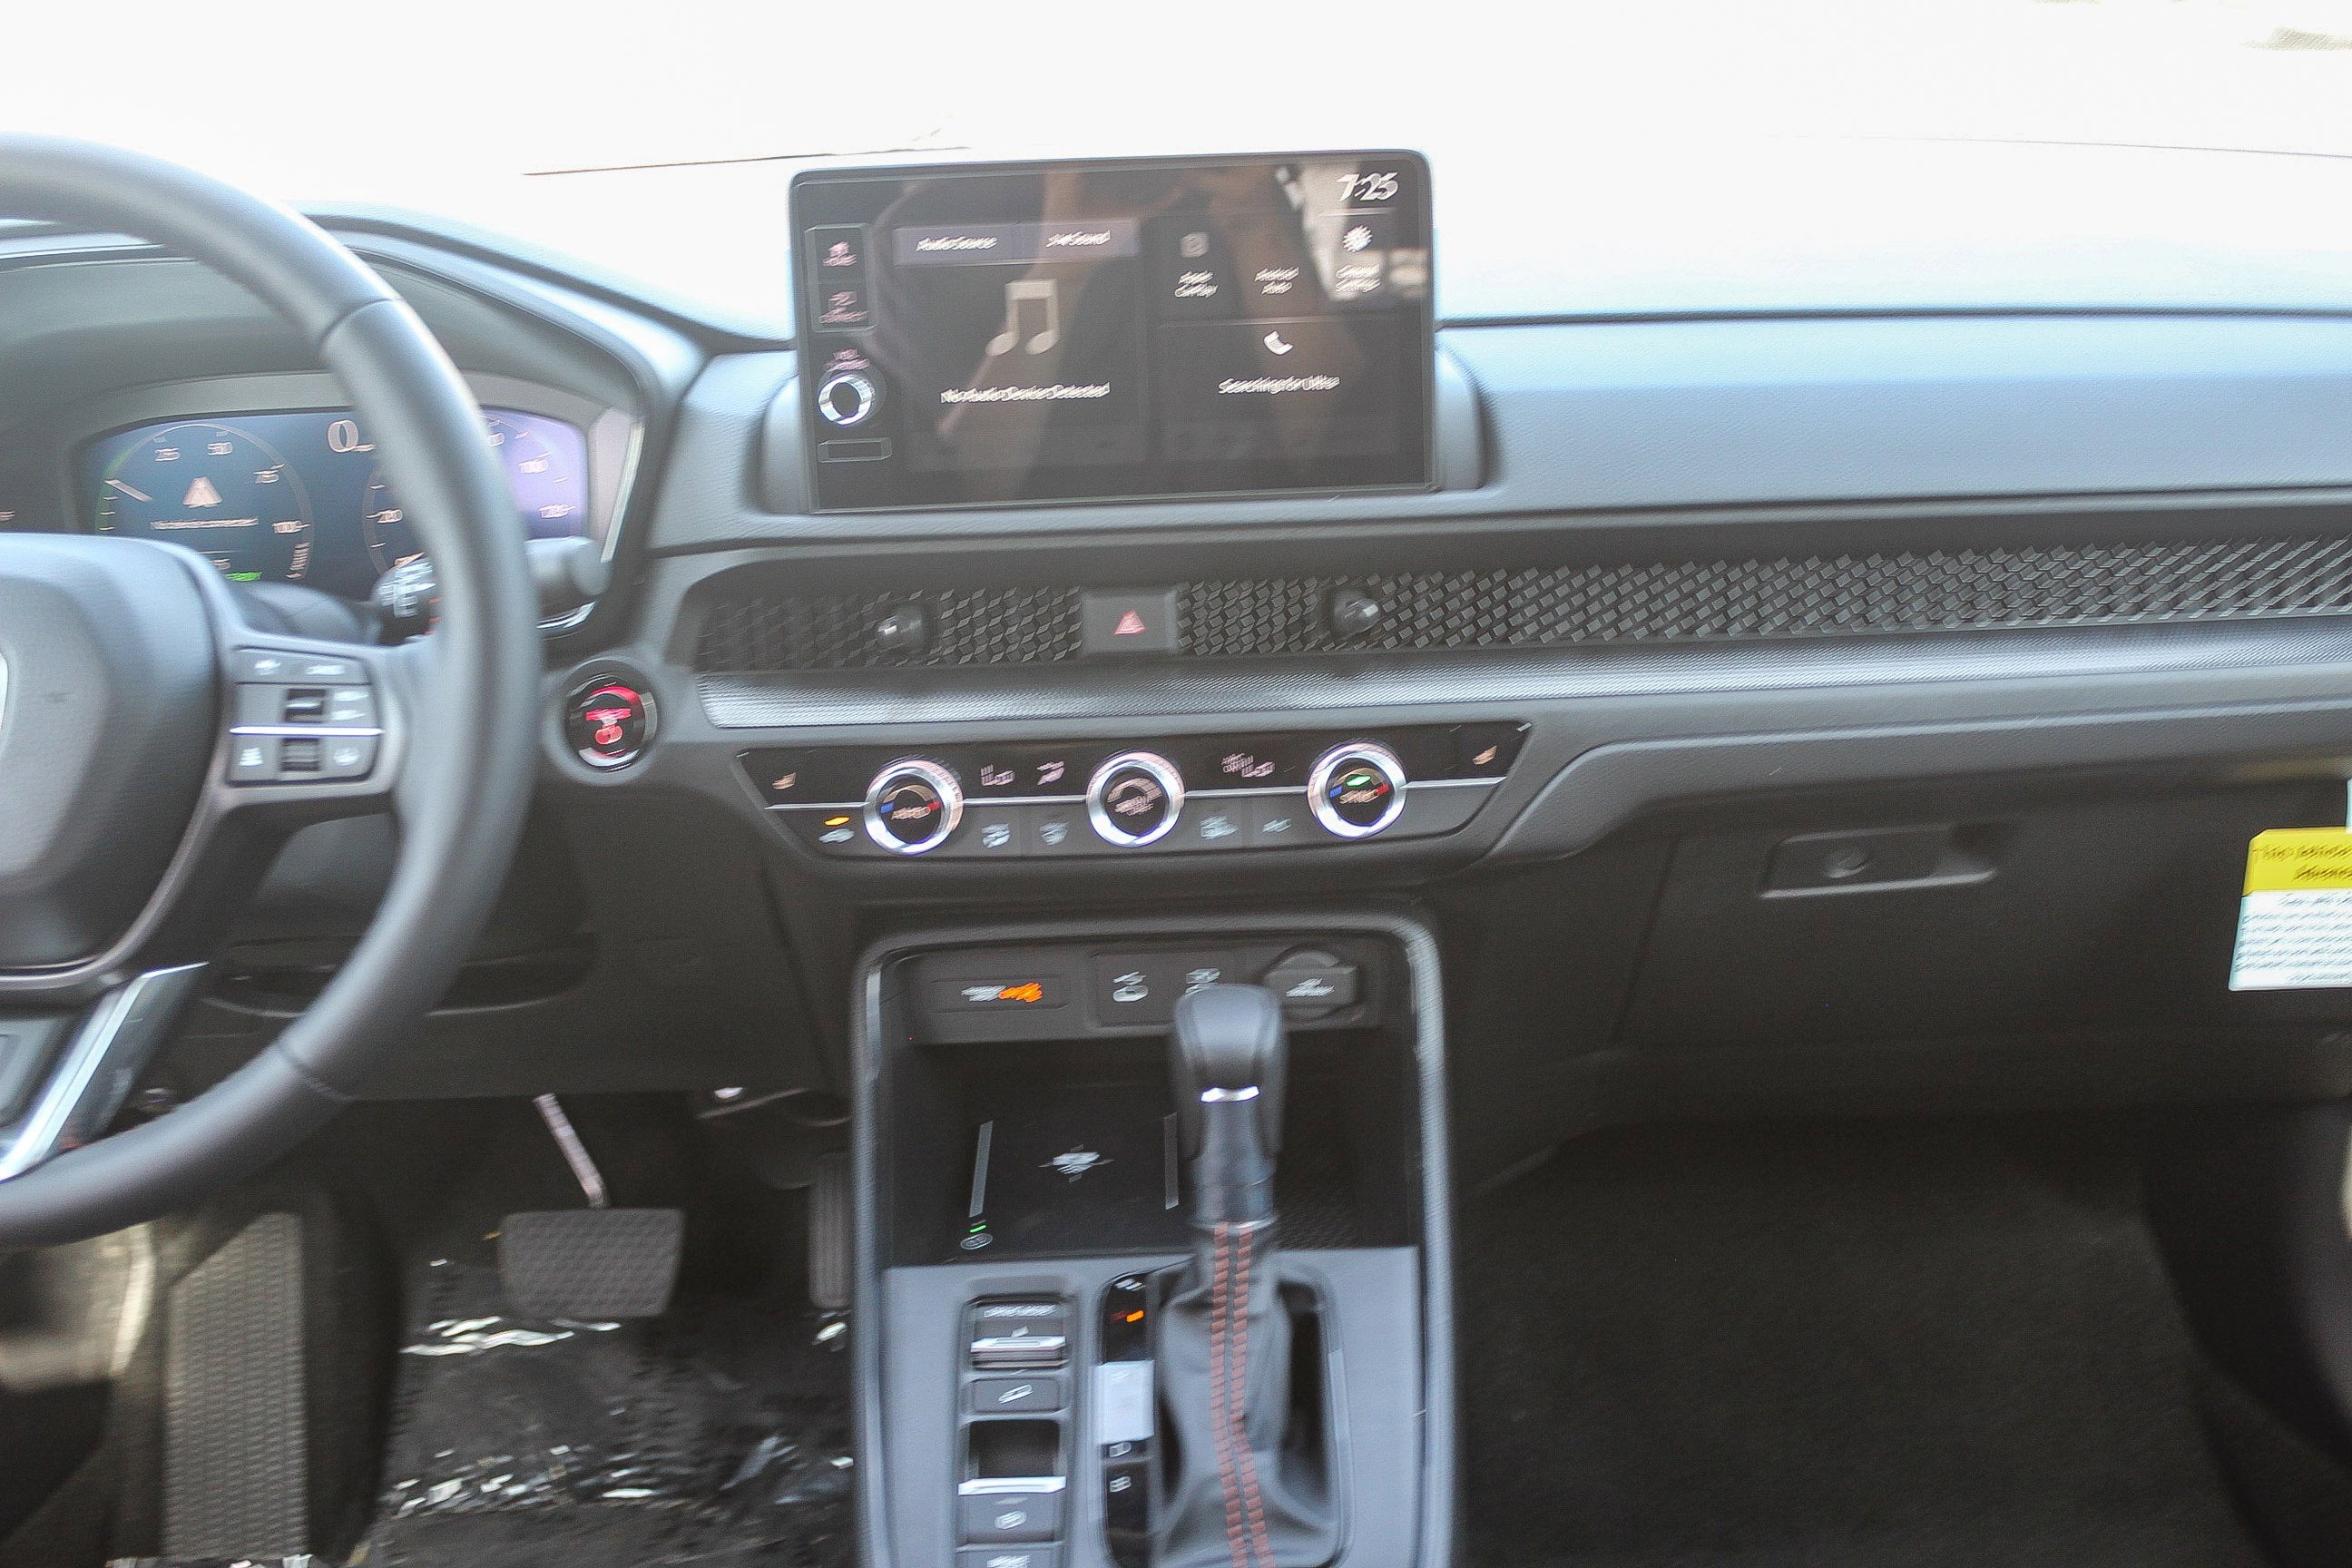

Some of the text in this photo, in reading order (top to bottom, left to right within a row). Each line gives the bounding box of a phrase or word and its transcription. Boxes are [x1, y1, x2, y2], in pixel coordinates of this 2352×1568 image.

[1337, 172, 1398, 201] 7:25
[1219, 377, 1282, 395] Searching
[941, 389, 965, 404] No
[963, 387, 1004, 402] Audio
